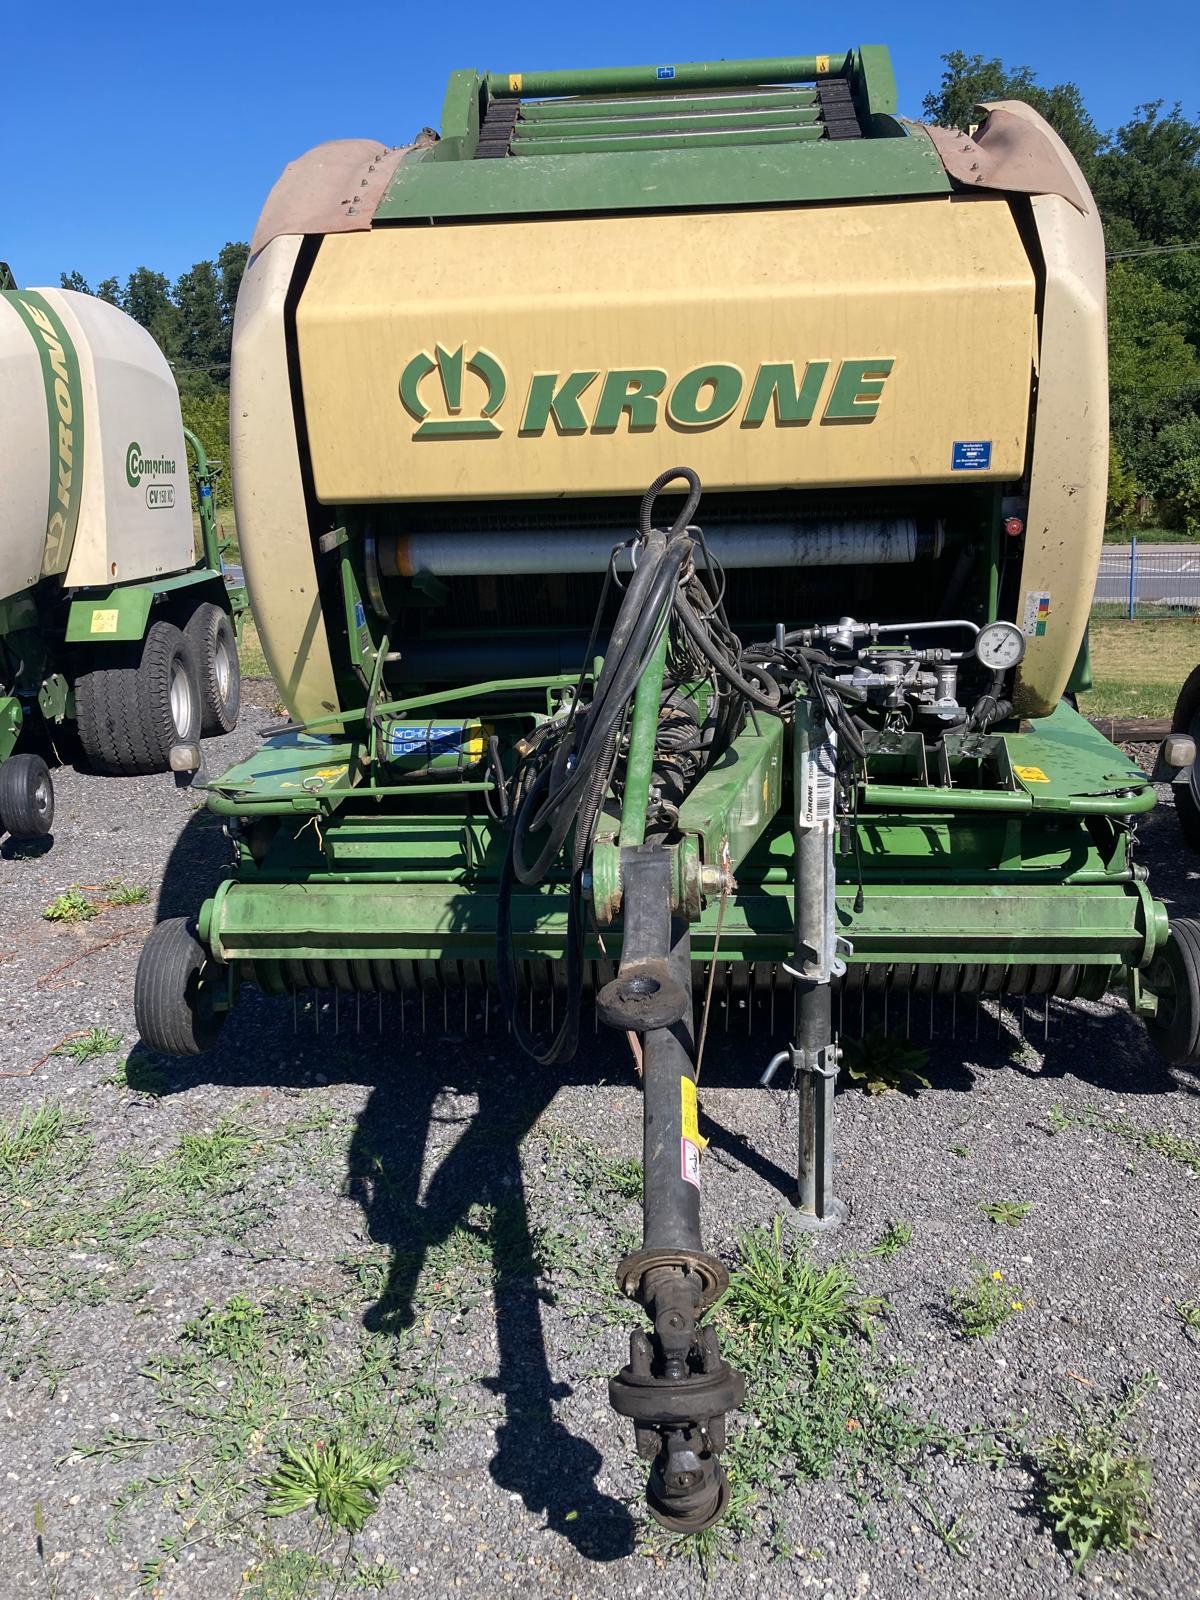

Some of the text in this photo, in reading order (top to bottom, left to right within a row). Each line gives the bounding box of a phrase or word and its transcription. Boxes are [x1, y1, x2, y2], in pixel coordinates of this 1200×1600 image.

[19, 299, 73, 509] KRONE
[518, 356, 895, 436] KRONE
[126, 442, 176, 488] Comprima
[149, 490, 158, 504] CV
